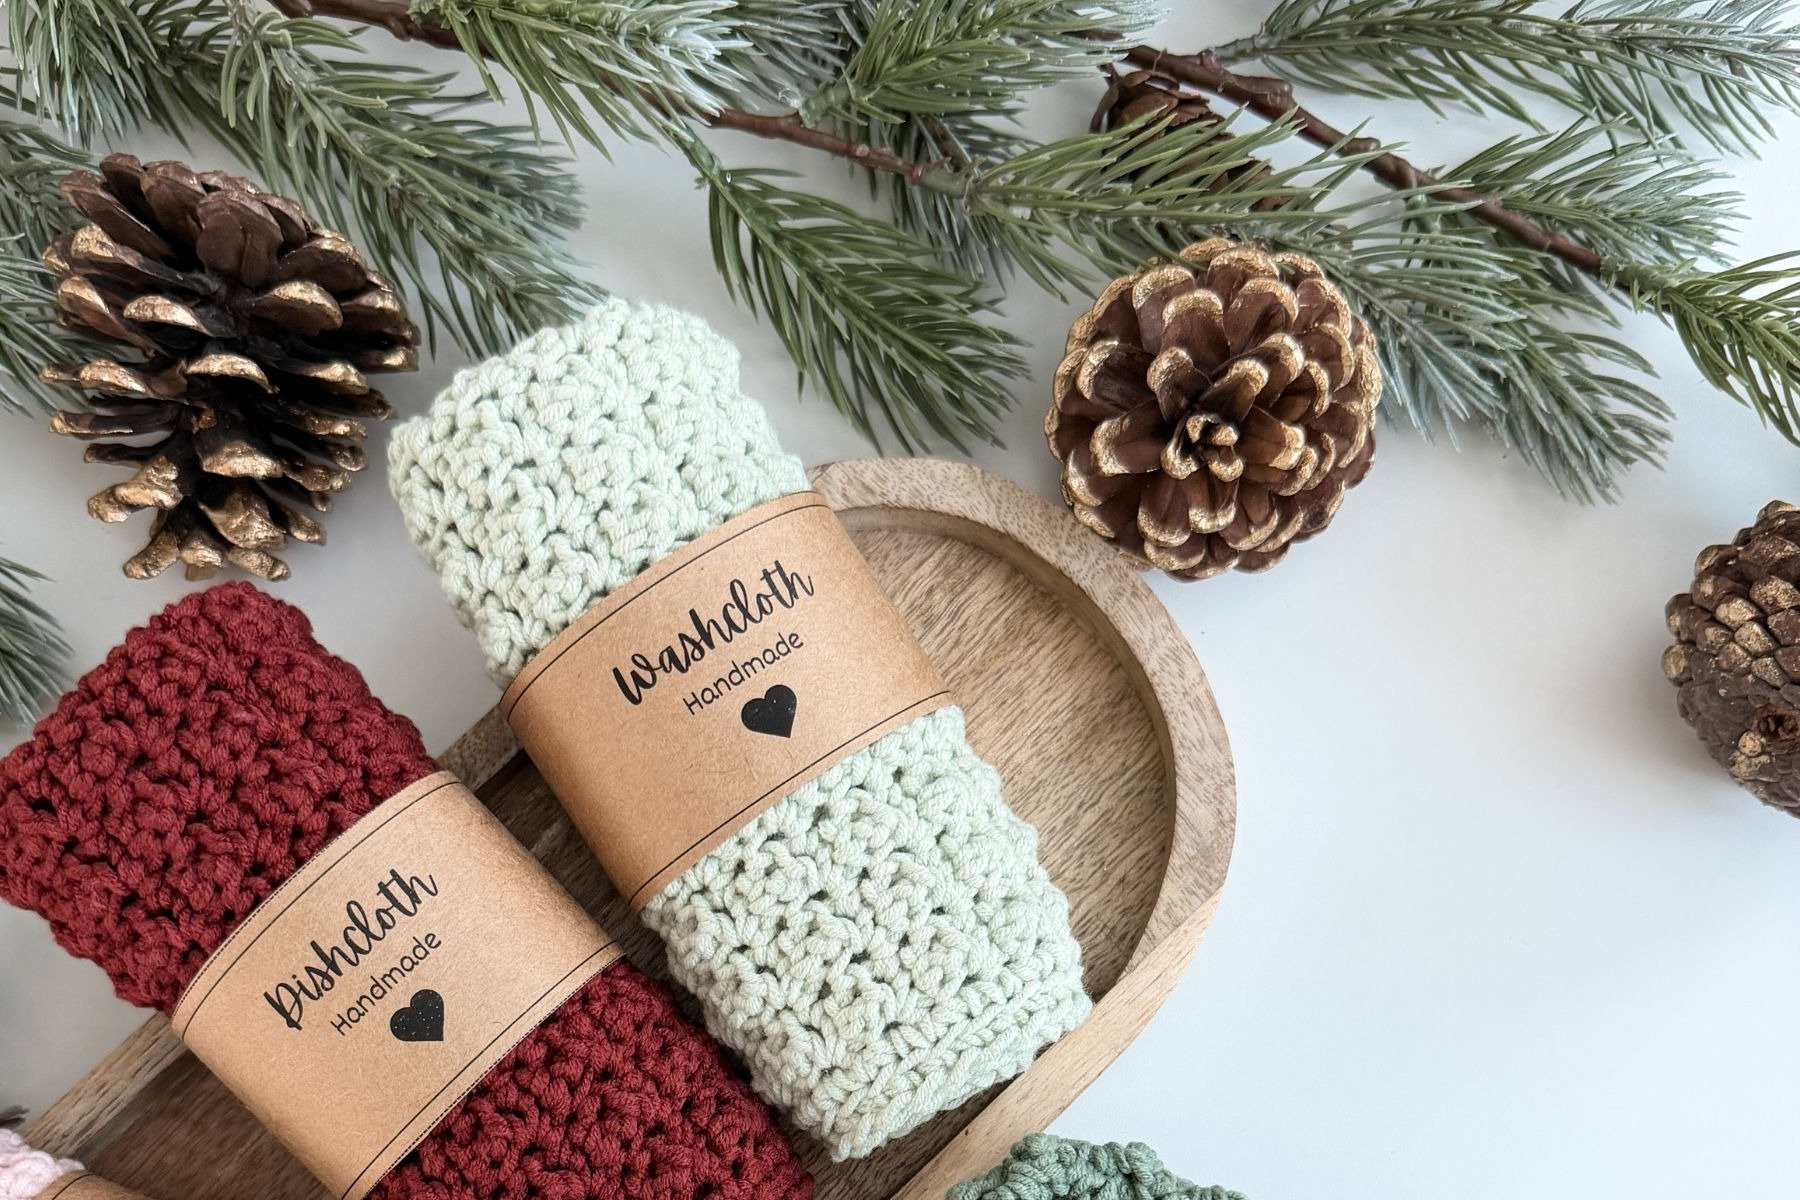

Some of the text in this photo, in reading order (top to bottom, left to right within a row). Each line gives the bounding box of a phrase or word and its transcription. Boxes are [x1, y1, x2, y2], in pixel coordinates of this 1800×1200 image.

[612, 560, 814, 706] Washcloth
[683, 632, 804, 716] Handmade
[263, 868, 439, 1031] Dishcloth
[330, 932, 442, 1036] Handmade
